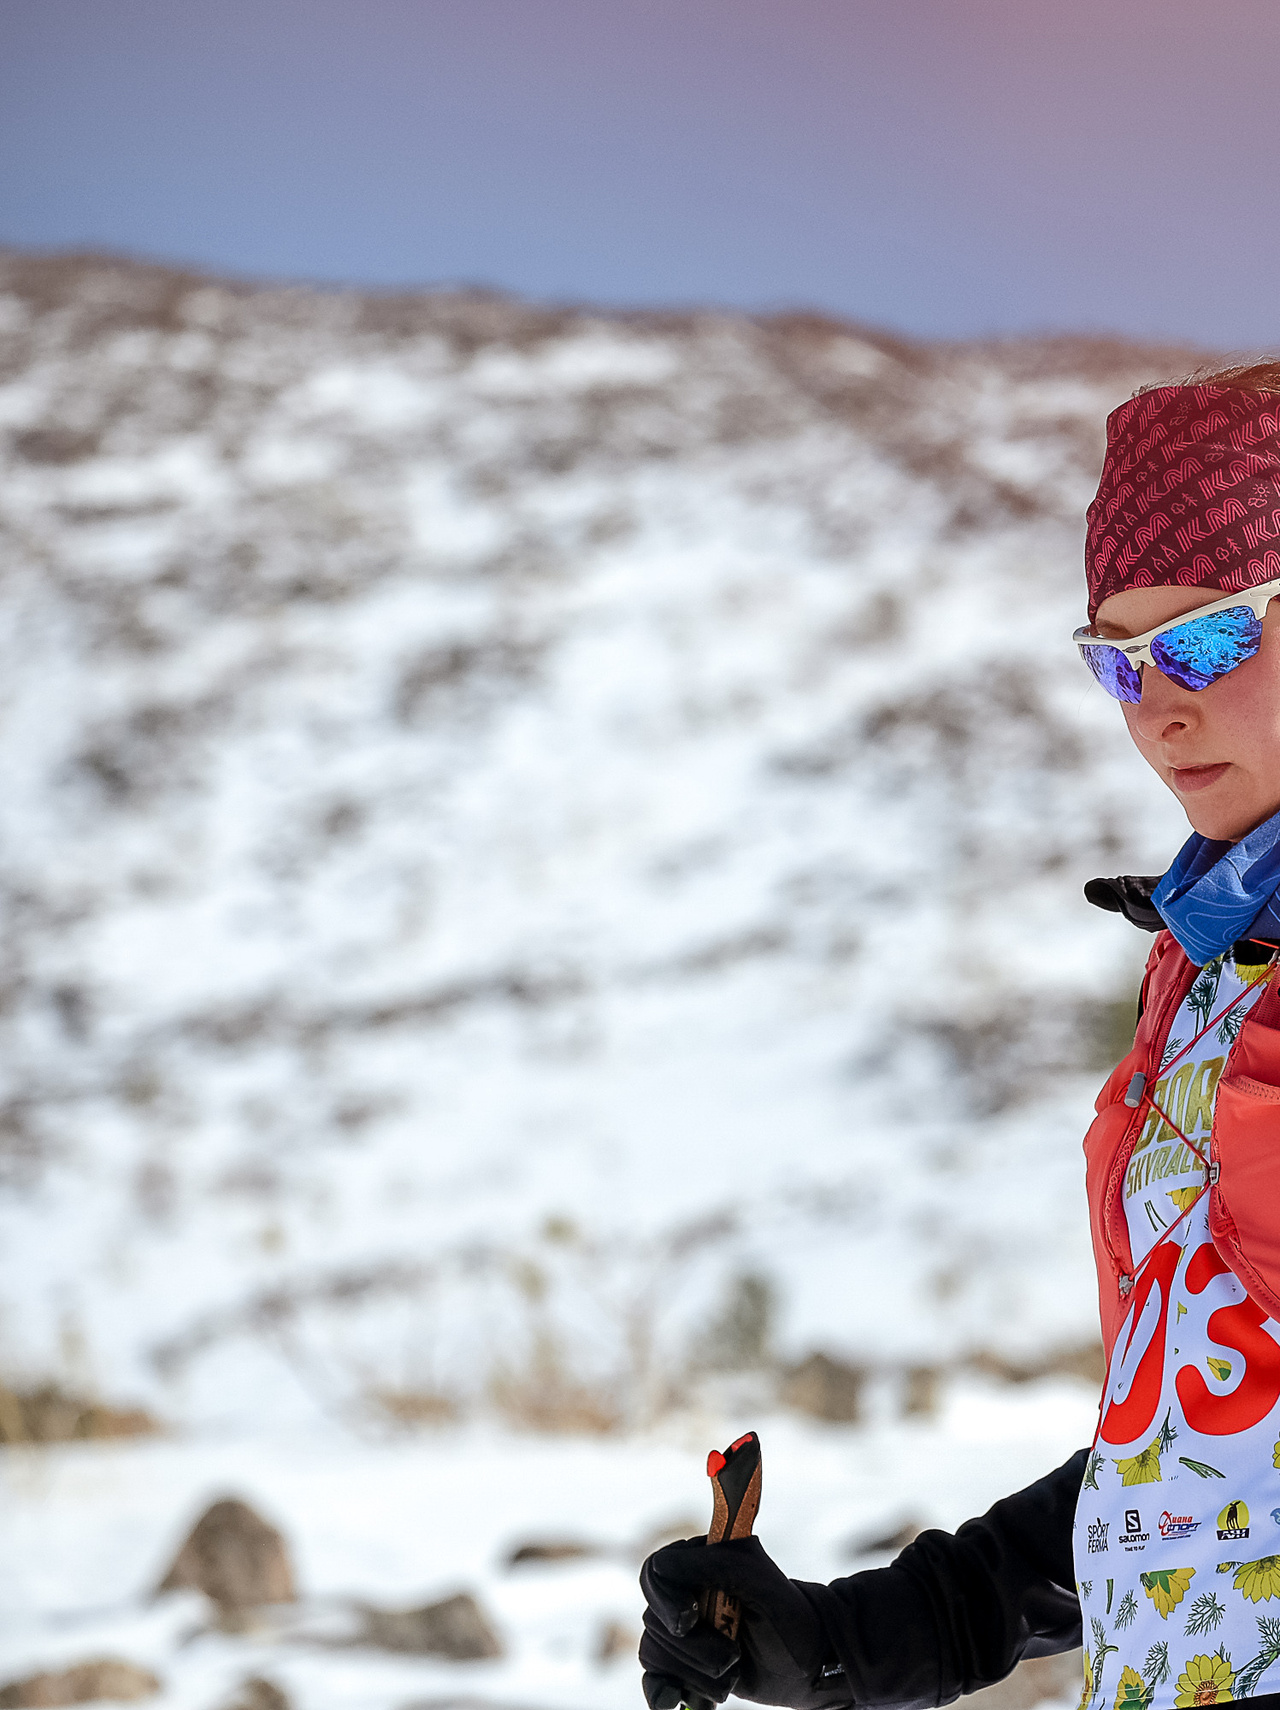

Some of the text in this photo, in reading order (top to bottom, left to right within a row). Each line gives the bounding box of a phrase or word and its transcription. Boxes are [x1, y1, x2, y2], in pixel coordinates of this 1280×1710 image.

[1113, 423, 1168, 486] KM
[1161, 410, 1229, 463] KM
[1136, 457, 1203, 514] KM
[1198, 453, 1271, 500] KM
[1115, 512, 1172, 578] KM
[1175, 498, 1248, 552] KM
